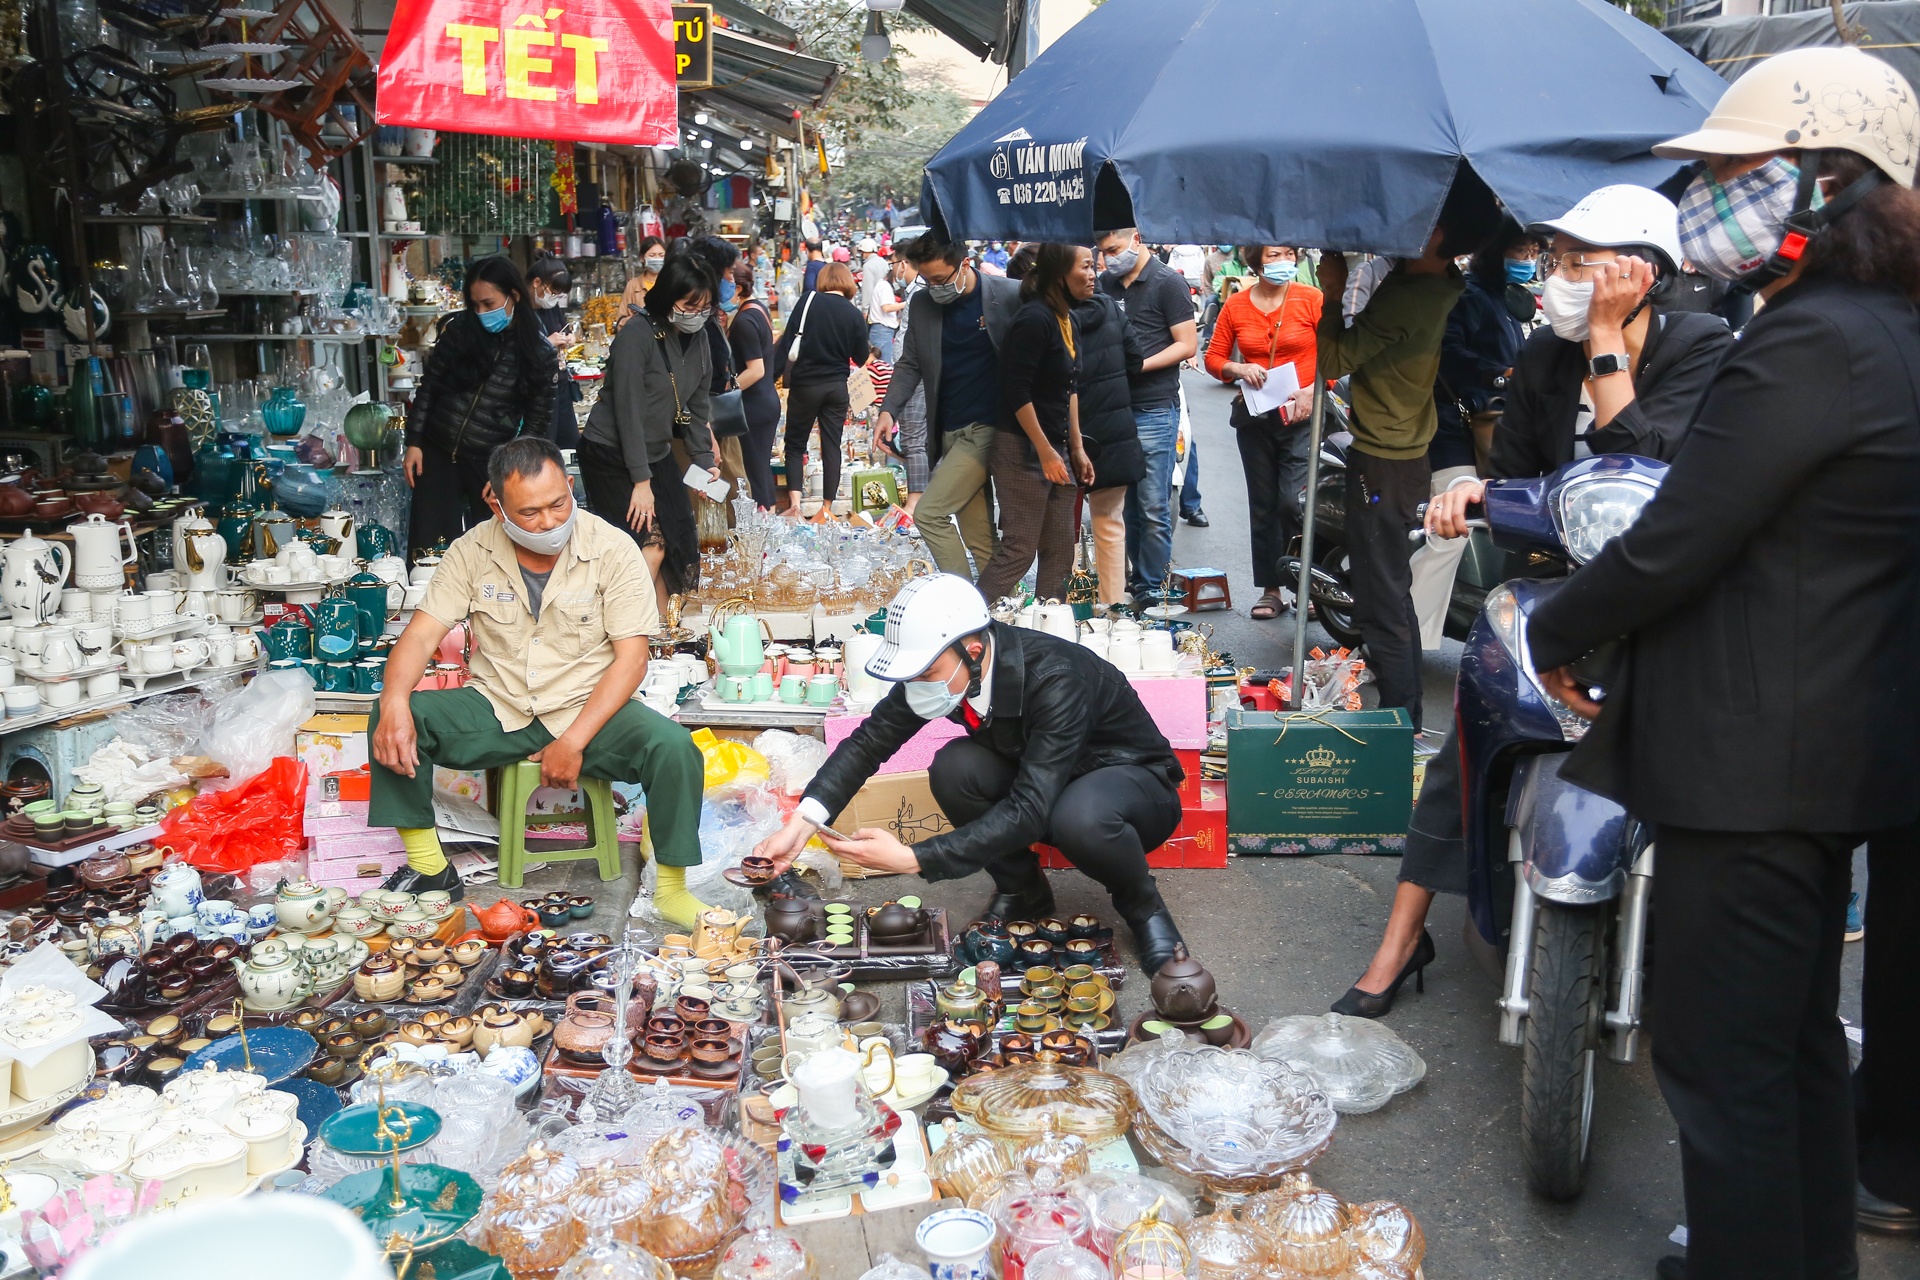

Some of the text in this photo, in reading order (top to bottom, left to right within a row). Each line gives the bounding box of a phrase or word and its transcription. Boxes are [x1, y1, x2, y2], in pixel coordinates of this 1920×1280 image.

[446, 8, 609, 105] TẾT
[1017, 142, 1046, 175] VĂN
[1014, 183, 1032, 205] 036
[1035, 181, 1057, 203] 220
[1296, 776, 1345, 784] SUBAISHI
[1273, 788, 1370, 799] CERAMICS
